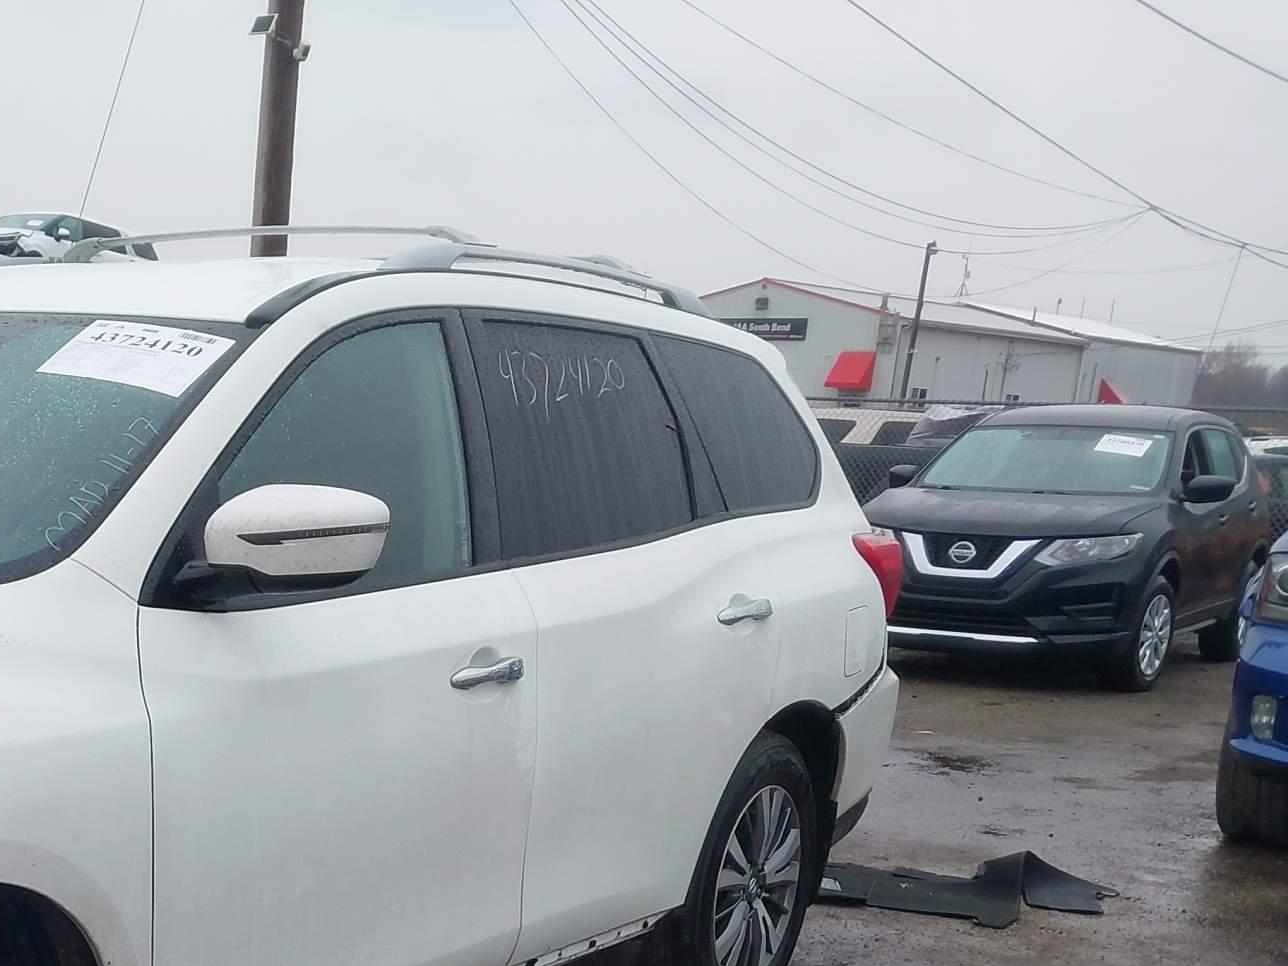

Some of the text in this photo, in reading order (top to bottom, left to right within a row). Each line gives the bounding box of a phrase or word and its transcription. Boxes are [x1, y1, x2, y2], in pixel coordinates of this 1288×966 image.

[749, 322, 770, 332] South
[772, 322, 791, 332] Bend
[90, 331, 204, 358] 43724120
